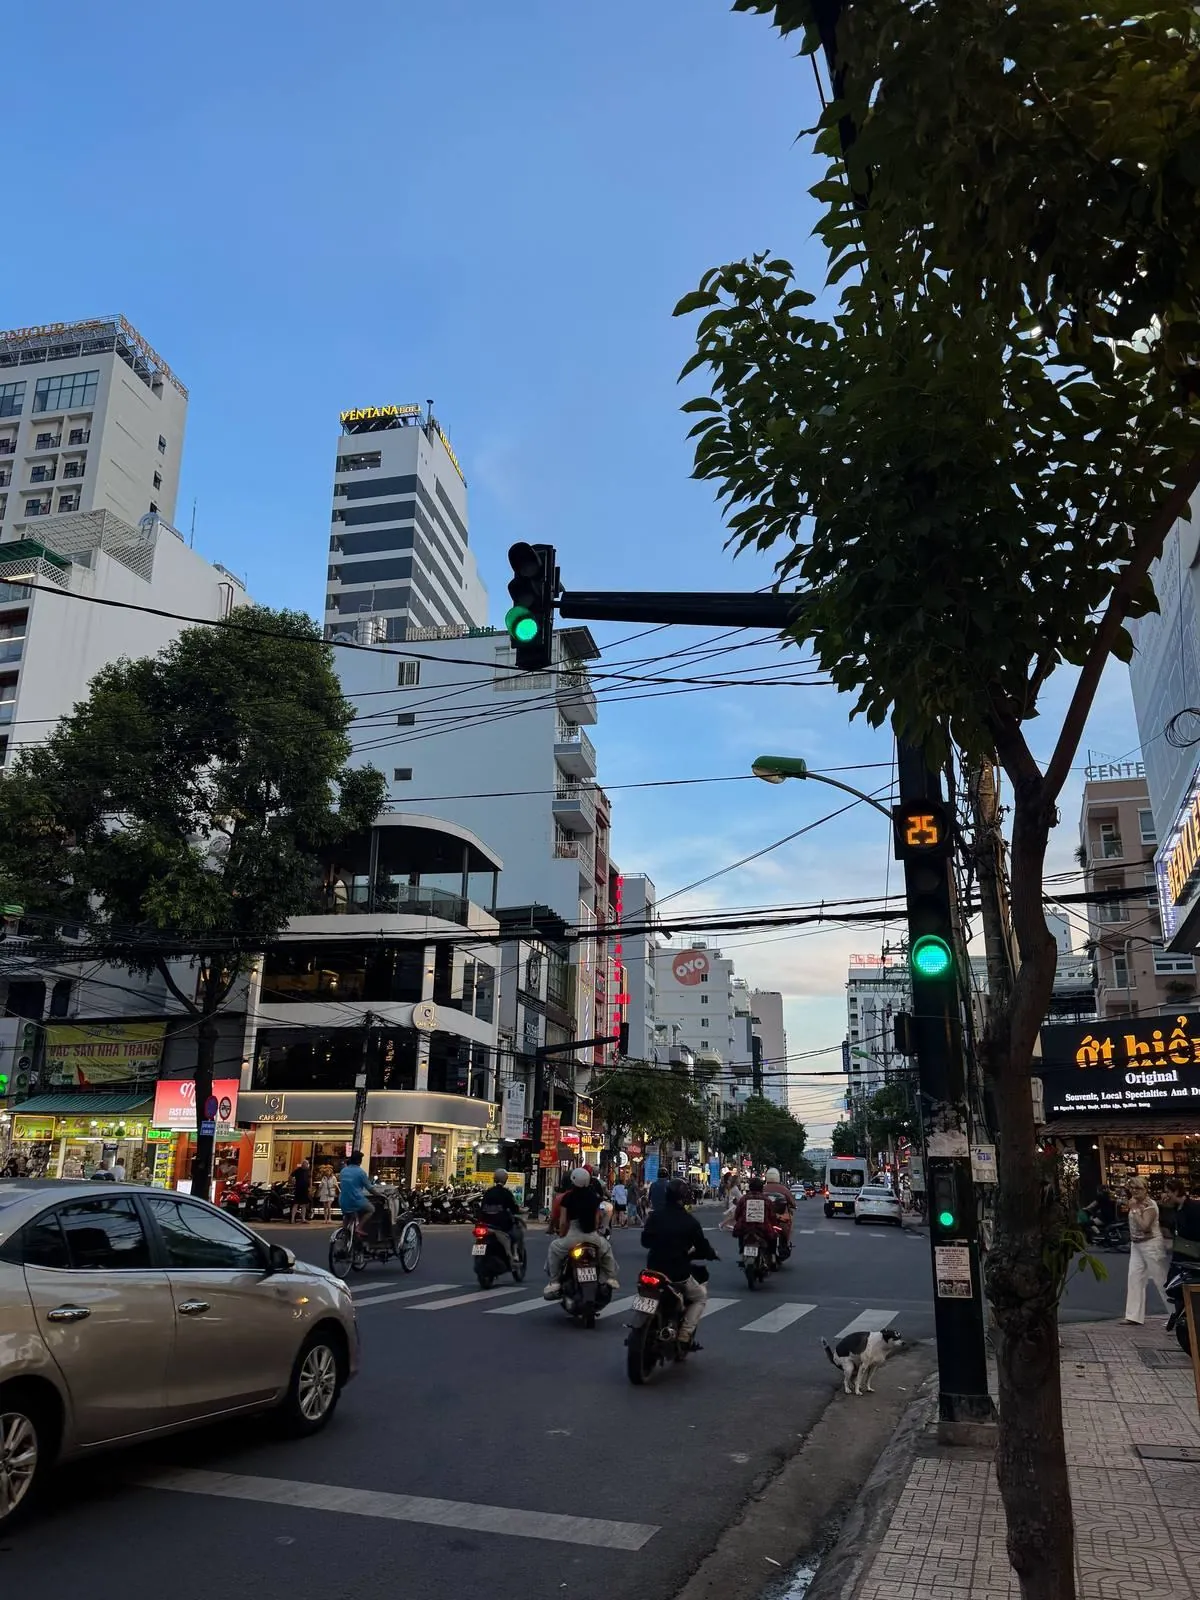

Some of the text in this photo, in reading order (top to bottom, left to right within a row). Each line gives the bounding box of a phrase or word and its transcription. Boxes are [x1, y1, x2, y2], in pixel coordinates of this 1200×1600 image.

[340, 405, 398, 421] VENTANA
[907, 815, 938, 845] 25
[675, 957, 706, 977] OYO
[97, 1044, 119, 1057] NHA
[124, 1042, 160, 1056] TRANG
[1125, 1070, 1179, 1086] Original
[1065, 1092, 1100, 1102] Souvenir,
[1101, 1091, 1122, 1101] Local
[1125, 1089, 1168, 1101] Specialties
[1171, 1087, 1188, 1097] And
[256, 1143, 267, 1153] 21
